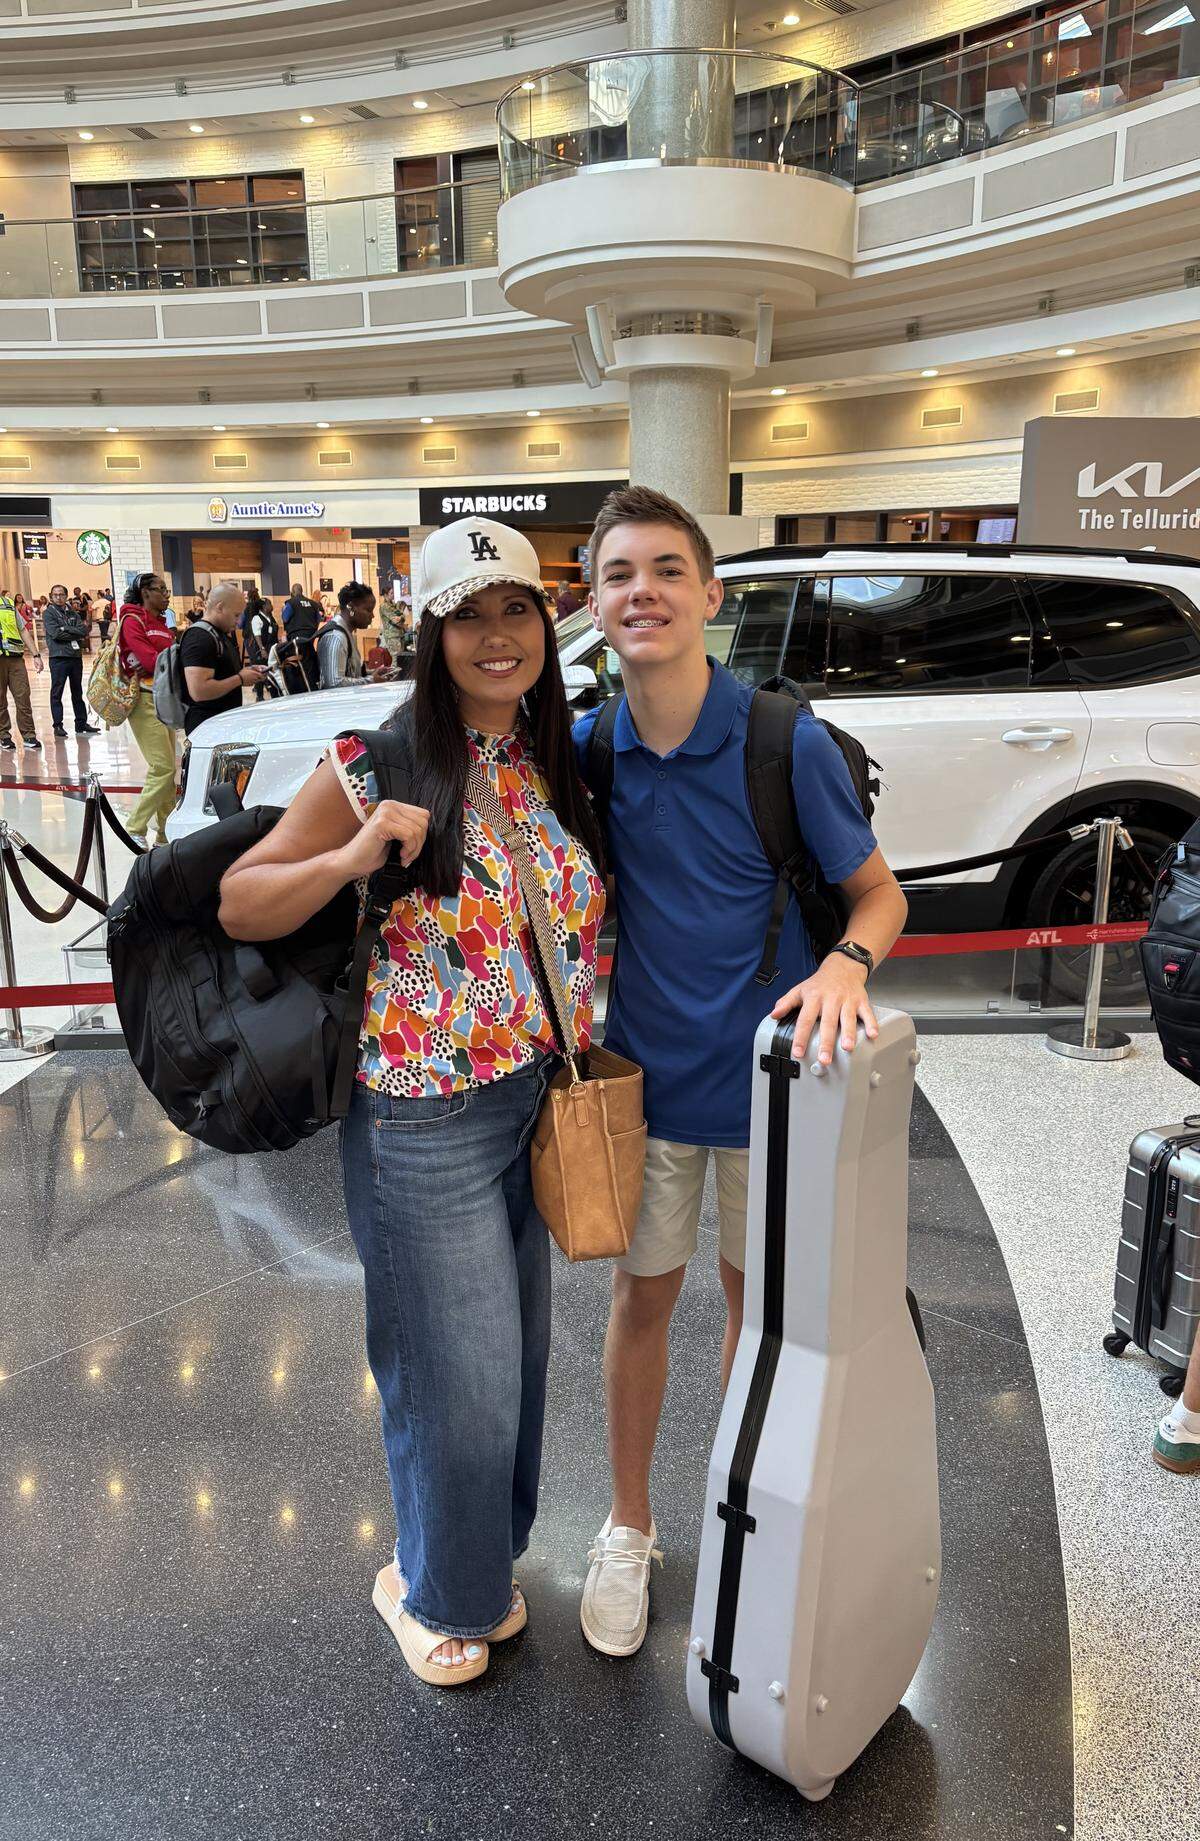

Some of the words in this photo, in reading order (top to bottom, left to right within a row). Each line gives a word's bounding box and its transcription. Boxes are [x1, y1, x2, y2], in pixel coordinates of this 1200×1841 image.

[231, 503, 276, 516] Auntie
[276, 503, 321, 515] Anne's
[442, 494, 547, 513] STARBUCKS
[1078, 508, 1115, 529] The
[1120, 508, 1200, 529] Tellurid
[467, 531, 501, 561] LA
[1026, 930, 1063, 945] ATL
